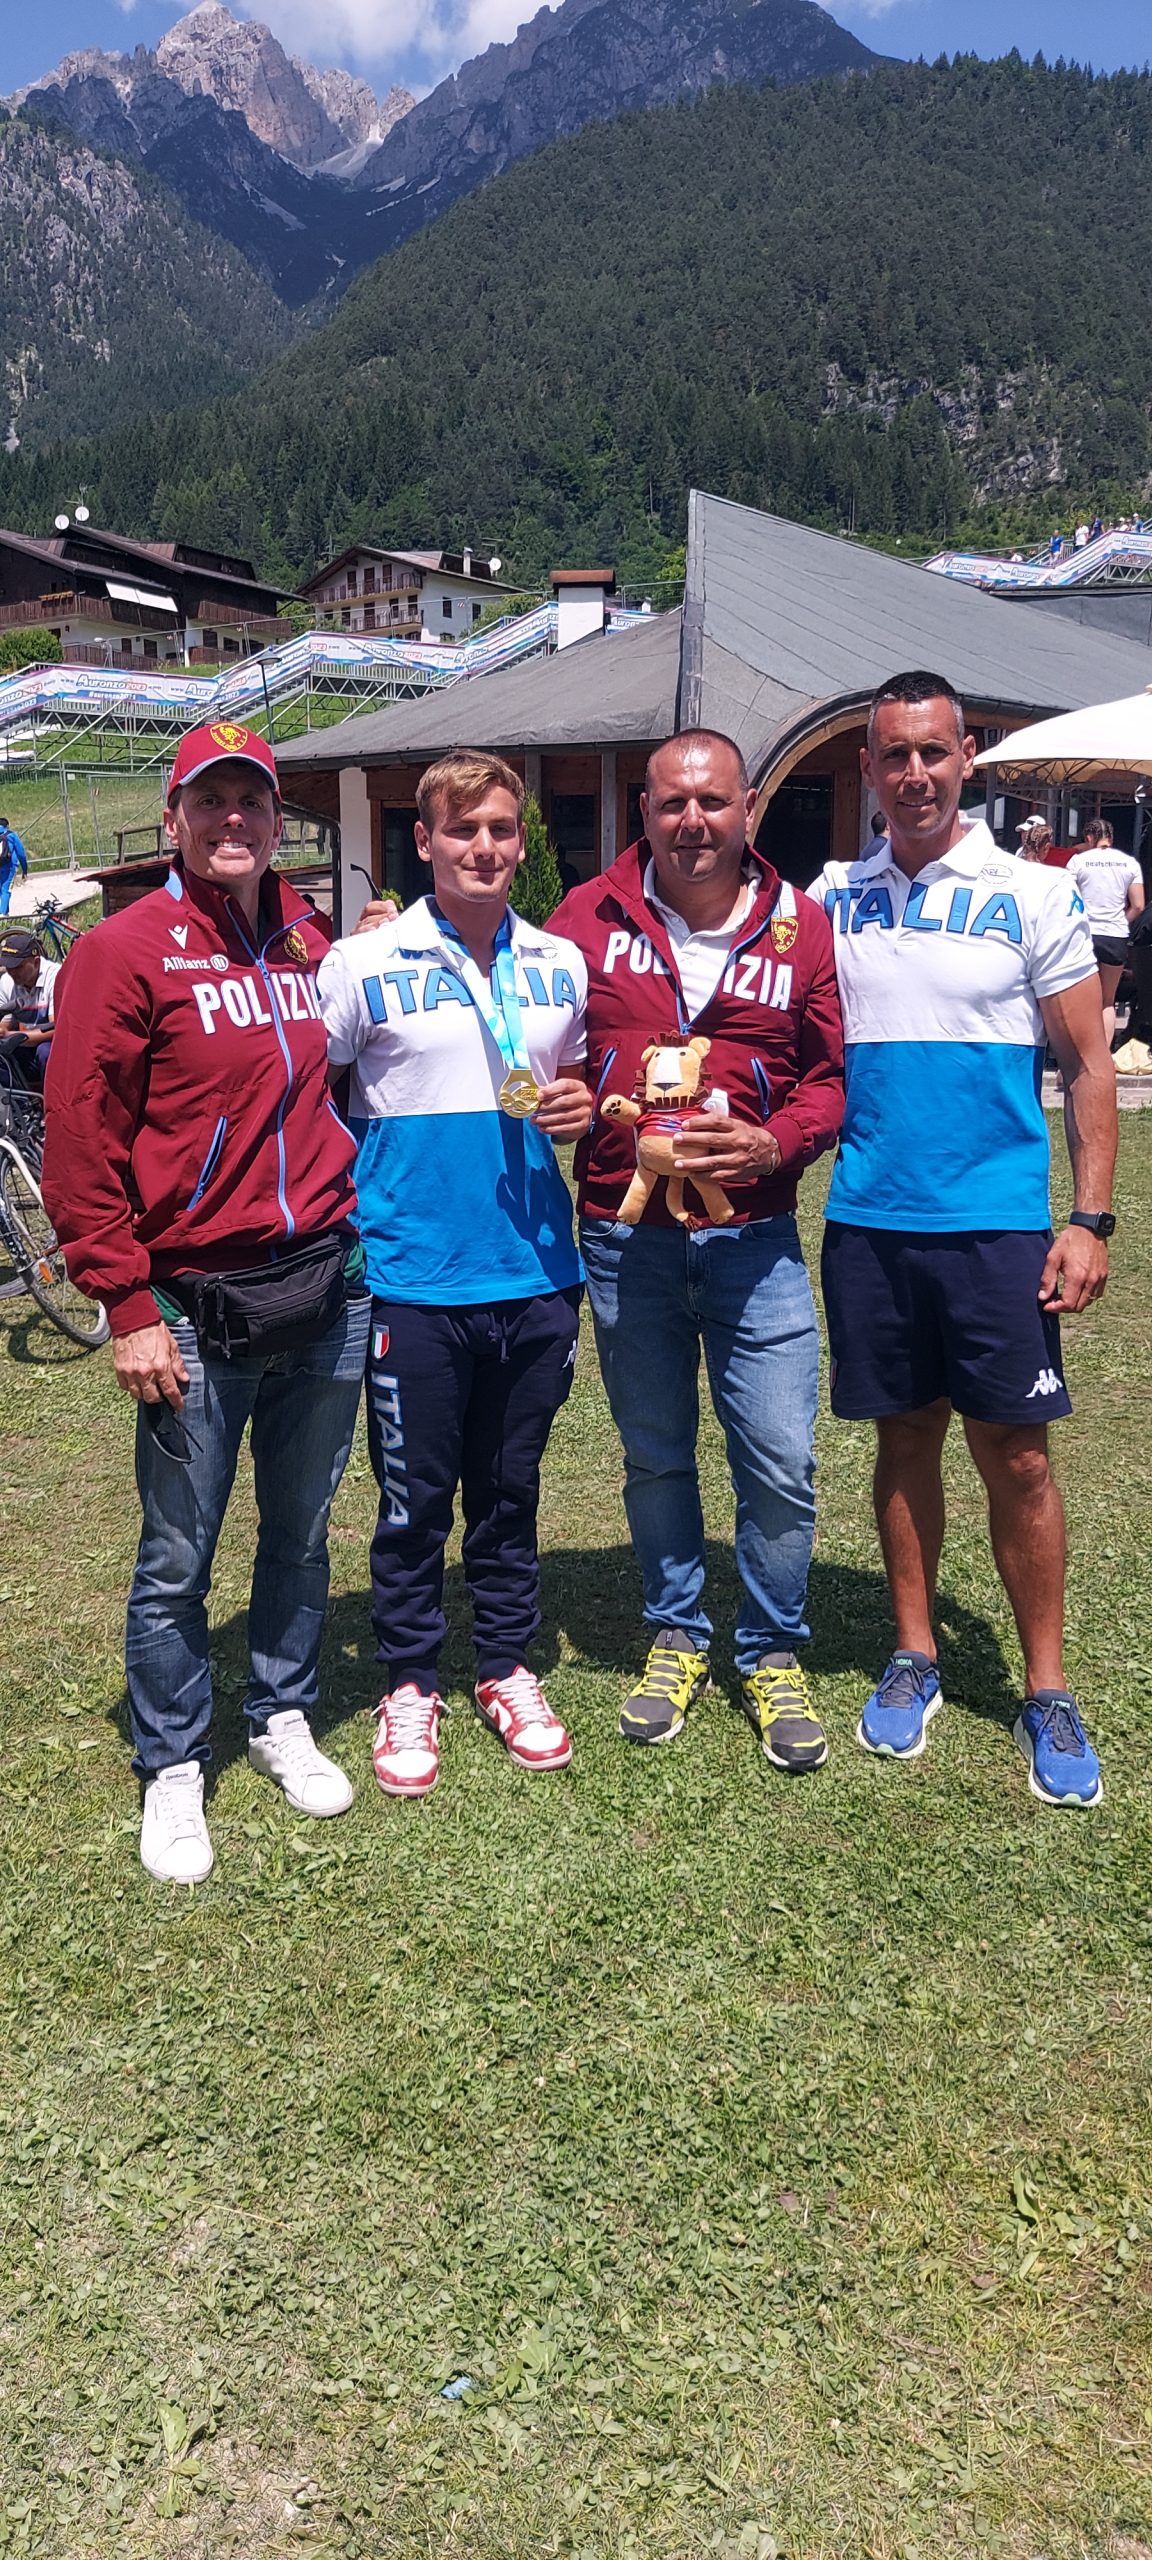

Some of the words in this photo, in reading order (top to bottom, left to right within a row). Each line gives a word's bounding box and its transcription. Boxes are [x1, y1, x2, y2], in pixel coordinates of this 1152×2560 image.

[824, 882, 1022, 944] ITALIA
[162, 956, 211, 972] Allianz
[603, 931, 793, 1011] POLIZIA
[371, 1371, 410, 1527] ITALIA
